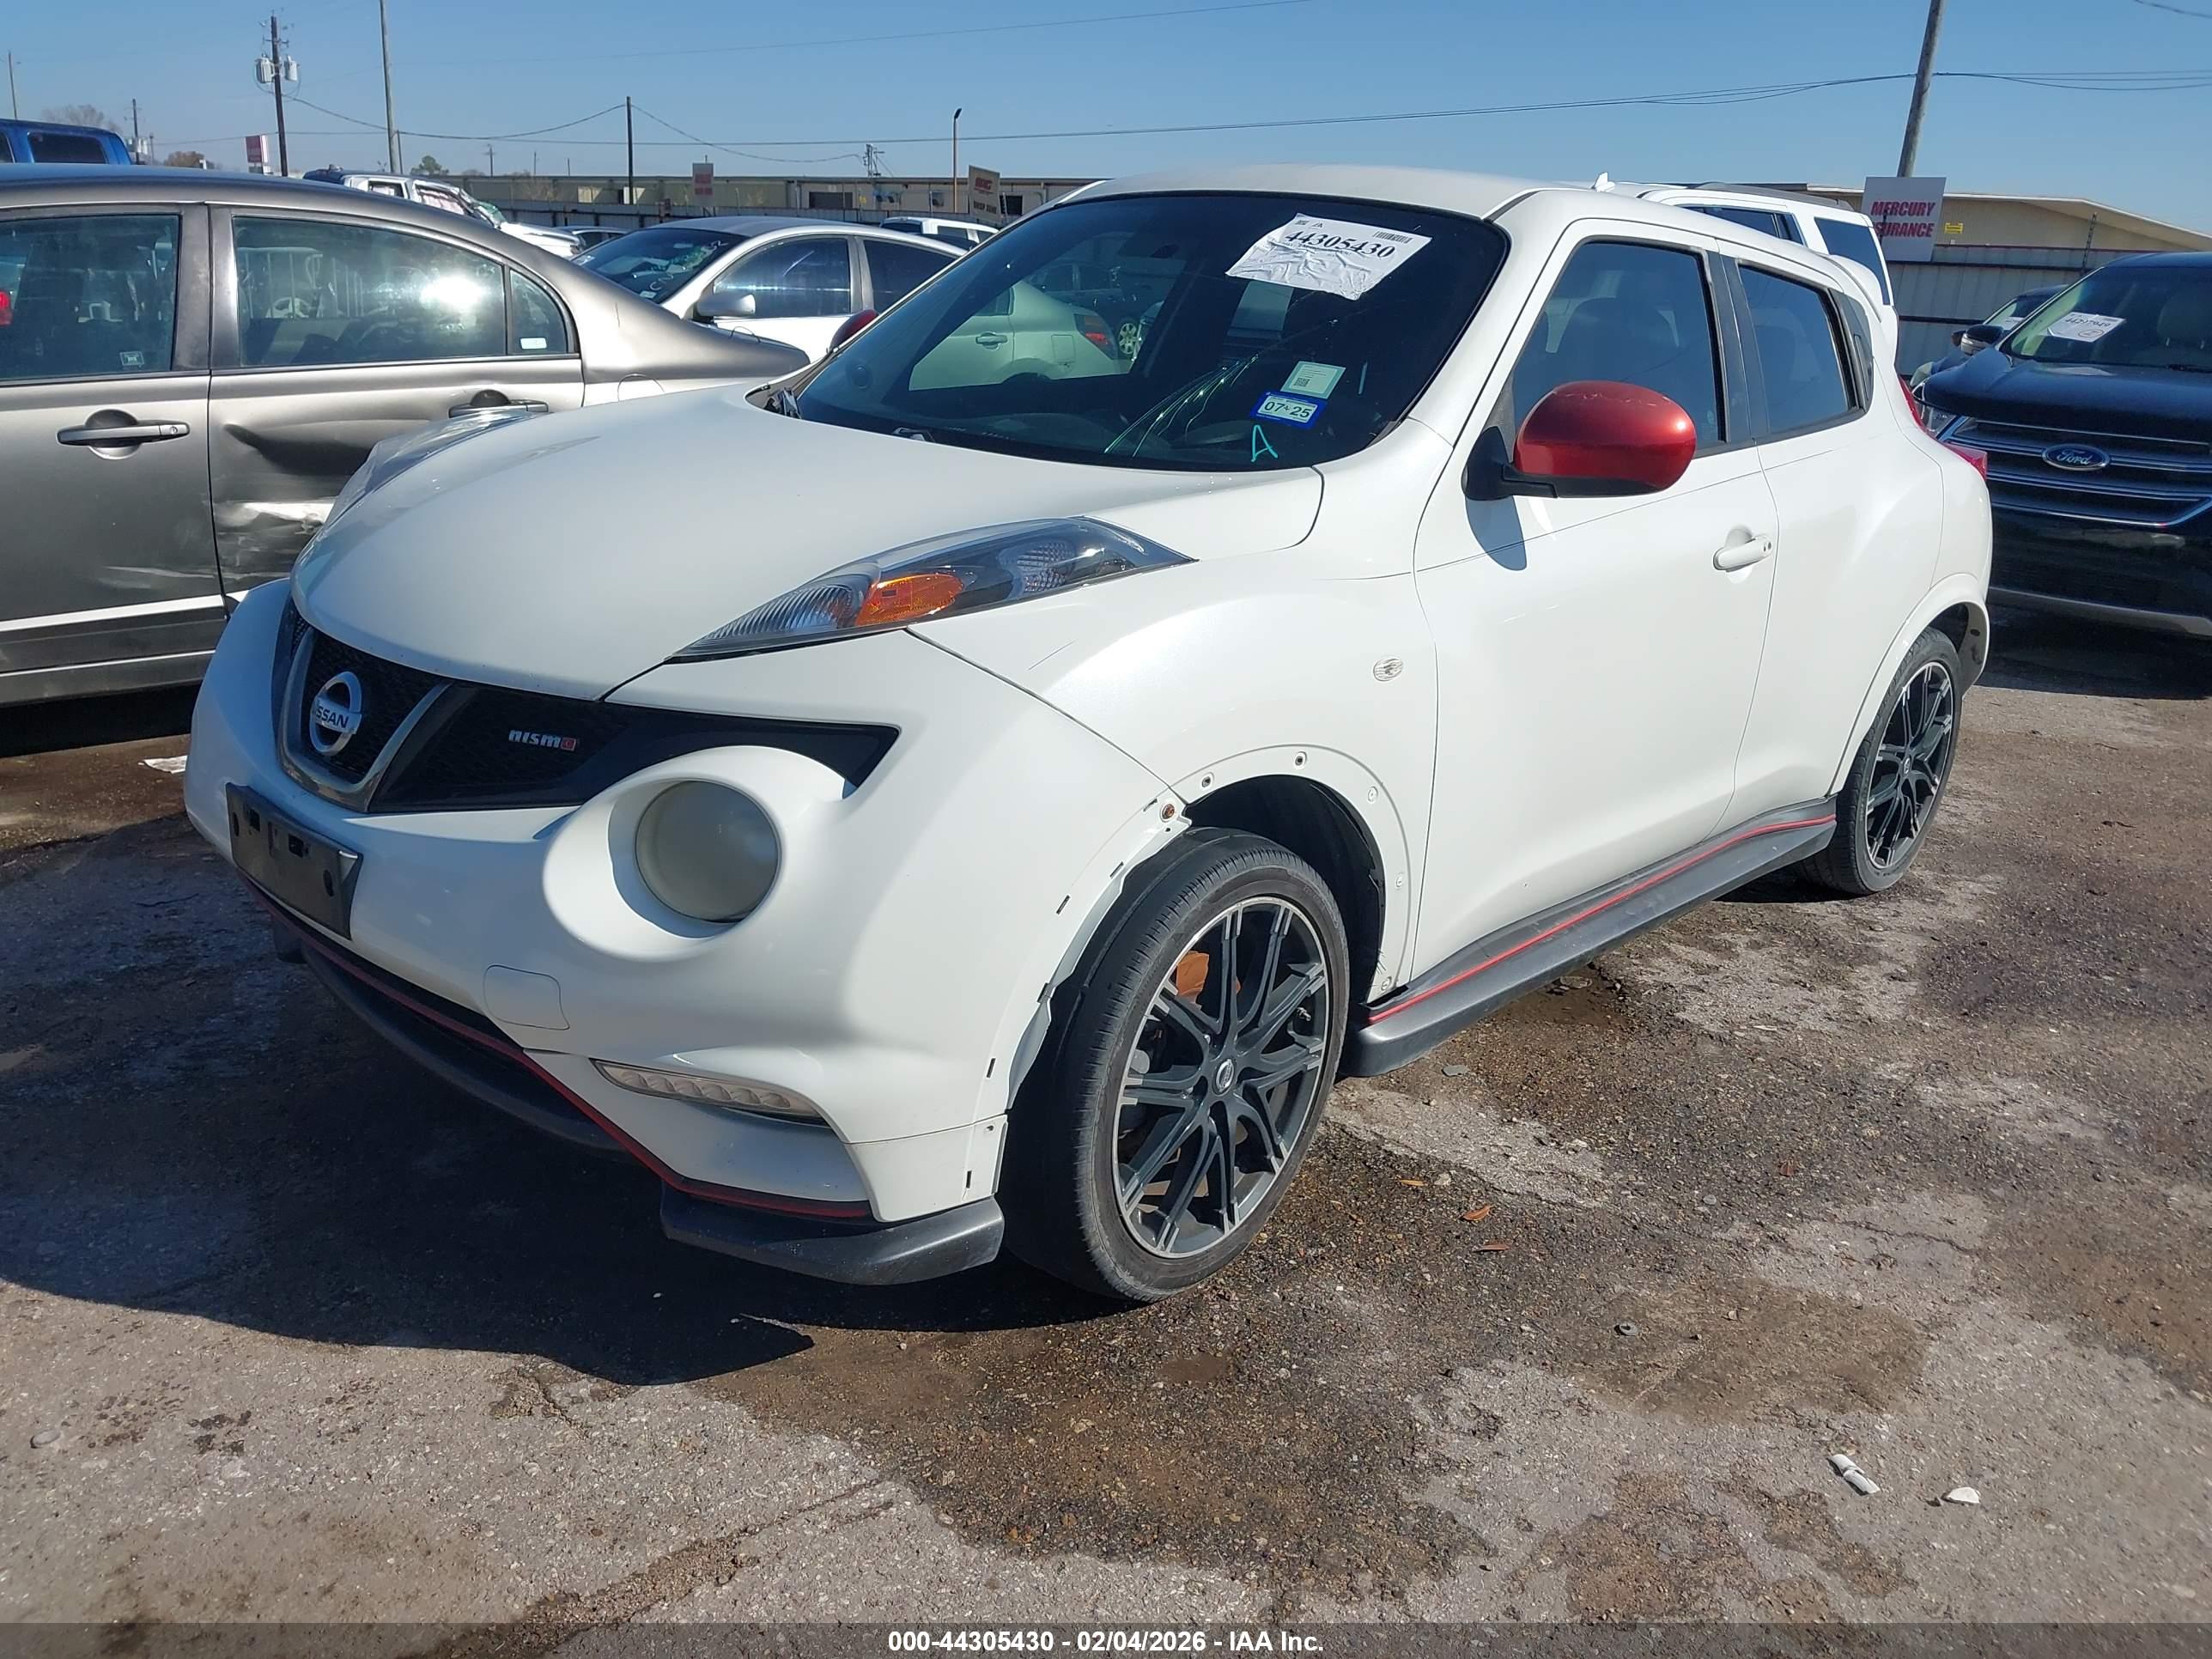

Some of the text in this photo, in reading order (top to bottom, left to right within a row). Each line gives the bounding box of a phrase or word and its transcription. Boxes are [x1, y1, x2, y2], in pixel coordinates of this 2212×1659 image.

[1870, 201, 1936, 216] MERCURY
[1874, 222, 1936, 237] SURANCE
[1285, 230, 1396, 259] 44305430
[1264, 401, 1313, 418] 07 25
[1250, 424, 1279, 463] A
[2056, 448, 2094, 465] Ford
[315, 705, 349, 729] SSAN
